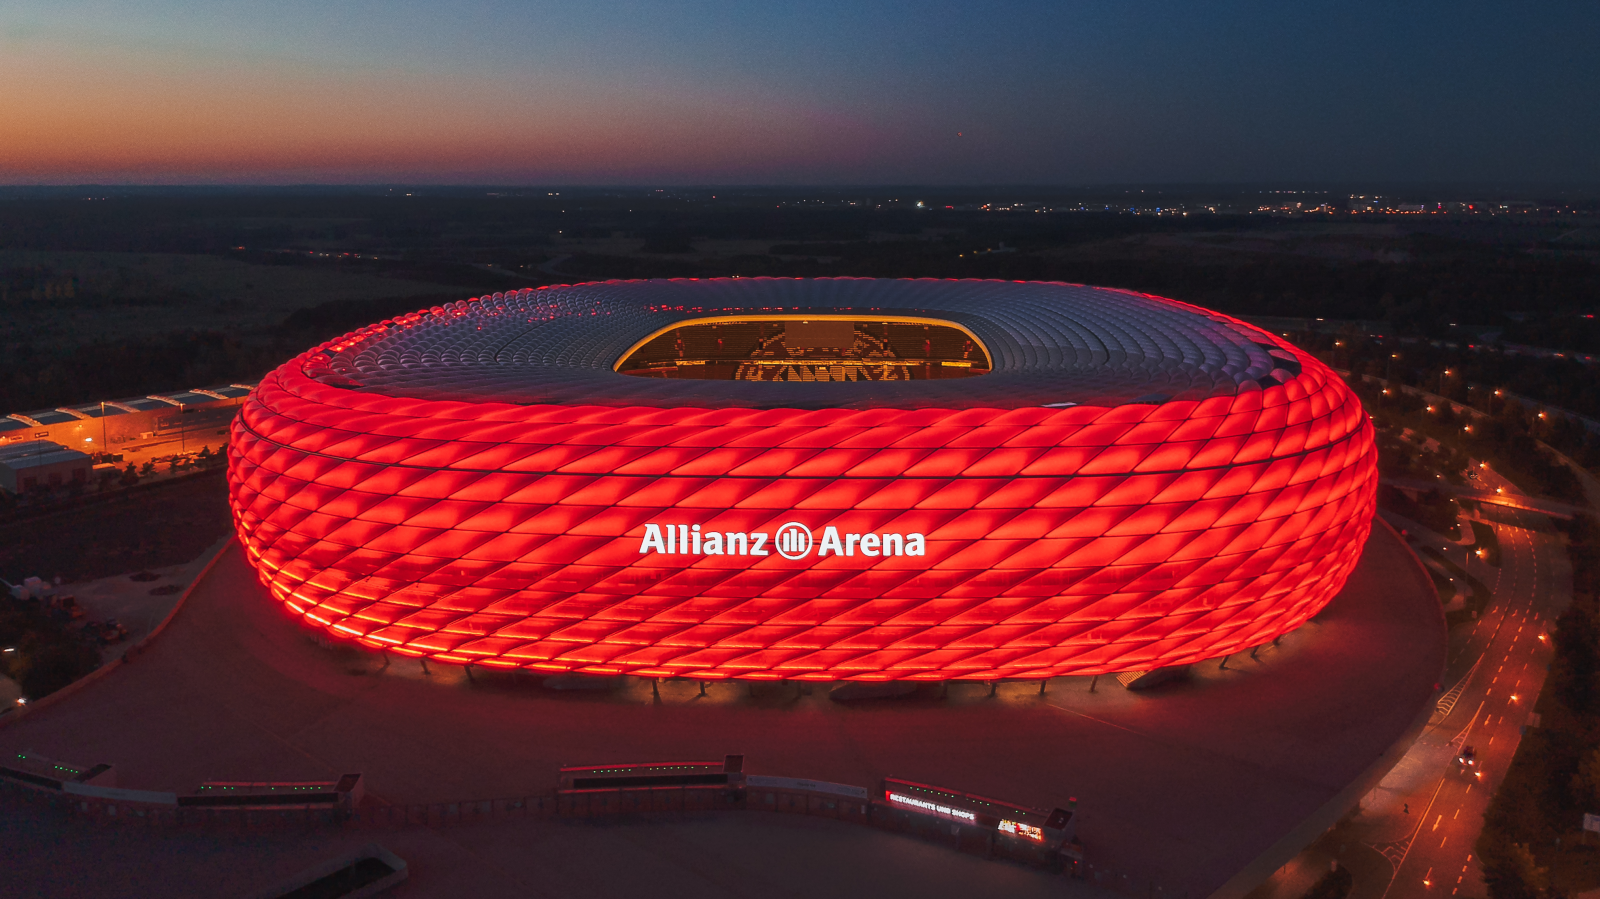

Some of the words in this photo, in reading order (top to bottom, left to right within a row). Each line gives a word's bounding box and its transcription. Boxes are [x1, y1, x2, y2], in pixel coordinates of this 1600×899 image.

[639, 523, 769, 555] Allianz
[818, 526, 925, 556] Arena
[890, 793, 936, 811] RESTAURANTS
[936, 805, 951, 814] UND
[952, 809, 975, 820] SHOPS
